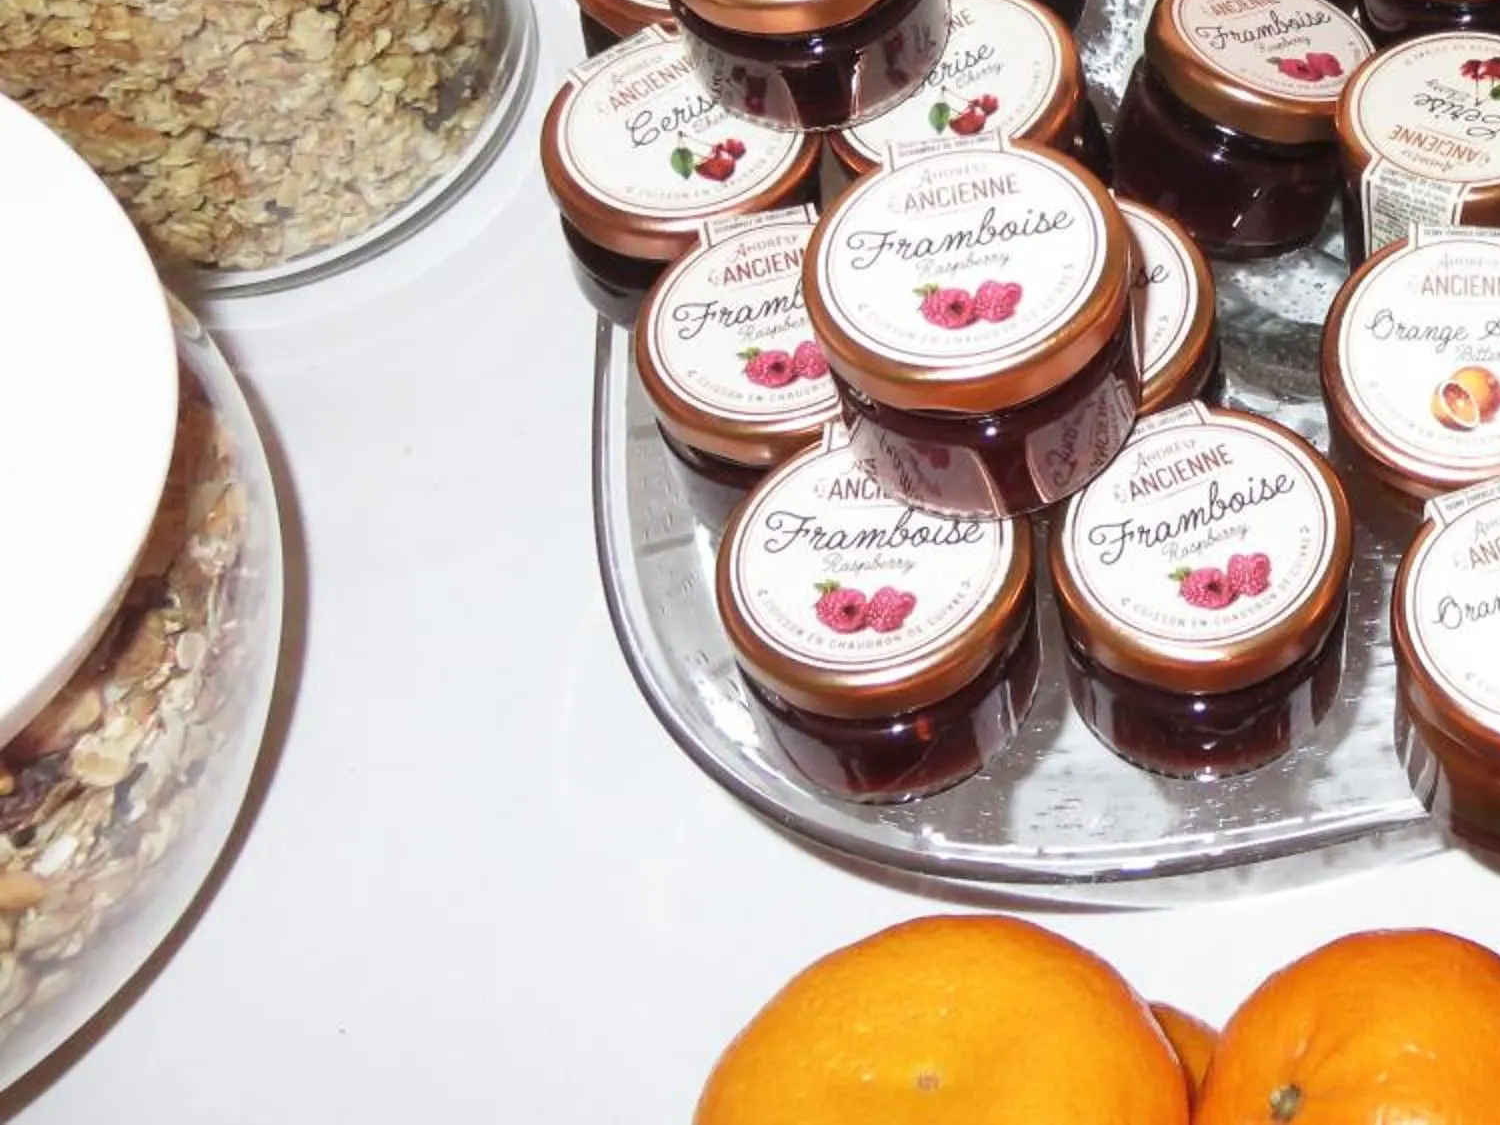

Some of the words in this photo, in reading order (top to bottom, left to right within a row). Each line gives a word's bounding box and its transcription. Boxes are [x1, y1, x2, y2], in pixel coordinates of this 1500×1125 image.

[1195, 9, 1332, 50] Framboise
[609, 55, 702, 113] ANCIENN
[923, 42, 996, 88] erise
[625, 92, 718, 149] Ceris
[1388, 124, 1481, 163] ANCIENNE
[904, 173, 1023, 214] ANCIENNE
[846, 206, 1076, 271] Framboise
[722, 249, 805, 286] ANCIEN
[916, 250, 1014, 278] Raspberry
[672, 280, 805, 340] Framb
[1364, 308, 1470, 355] Orange
[1128, 443, 1235, 502] ANCIENNE
[763, 509, 986, 555] Framboise
[1088, 473, 1296, 565] Framboise
[1162, 521, 1250, 563] Raspberry
[822, 551, 917, 576] Raspberry
